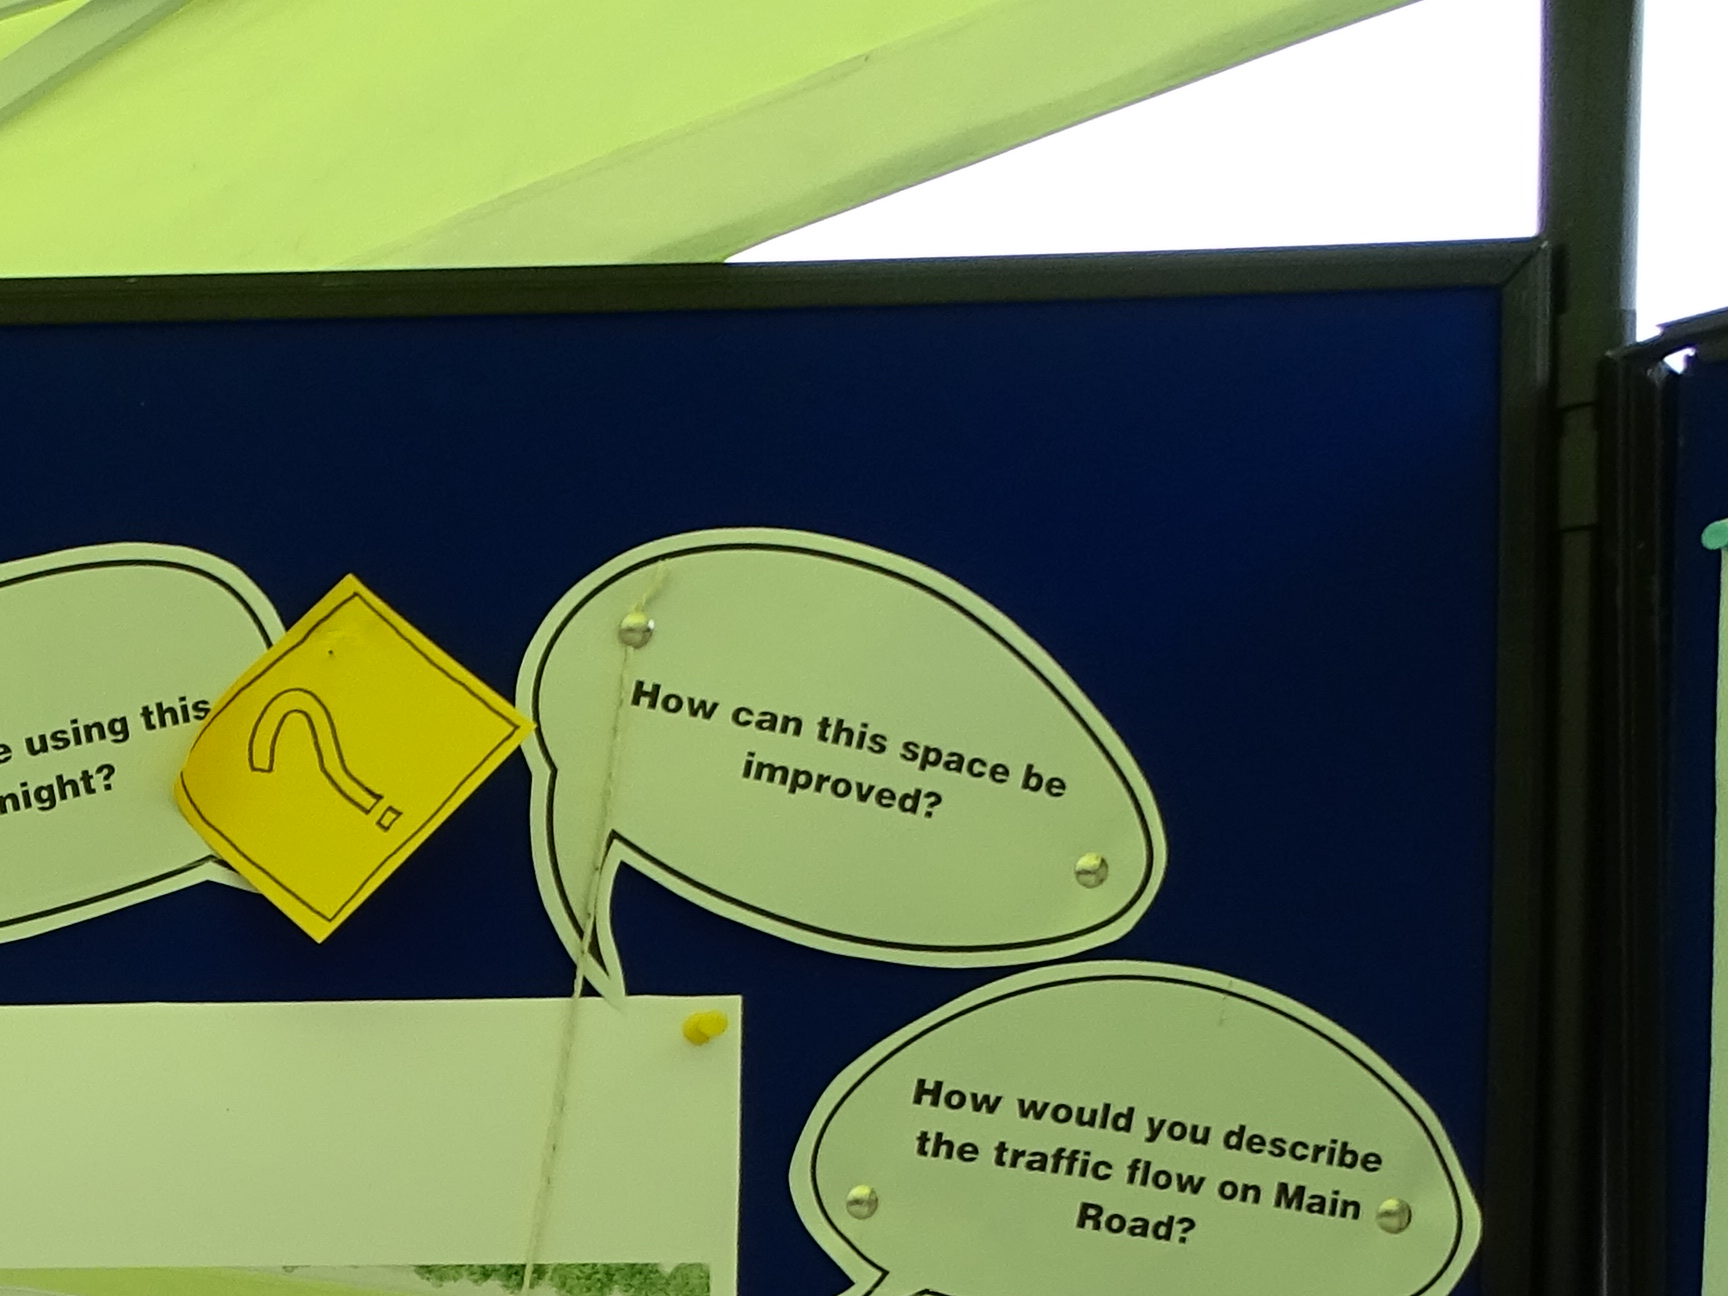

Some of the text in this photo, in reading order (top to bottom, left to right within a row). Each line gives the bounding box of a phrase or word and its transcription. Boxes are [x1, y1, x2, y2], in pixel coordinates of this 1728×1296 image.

[247, 687, 402, 831] ?
[630, 679, 1067, 798] How can this space be
[742, 751, 943, 819] improved?
